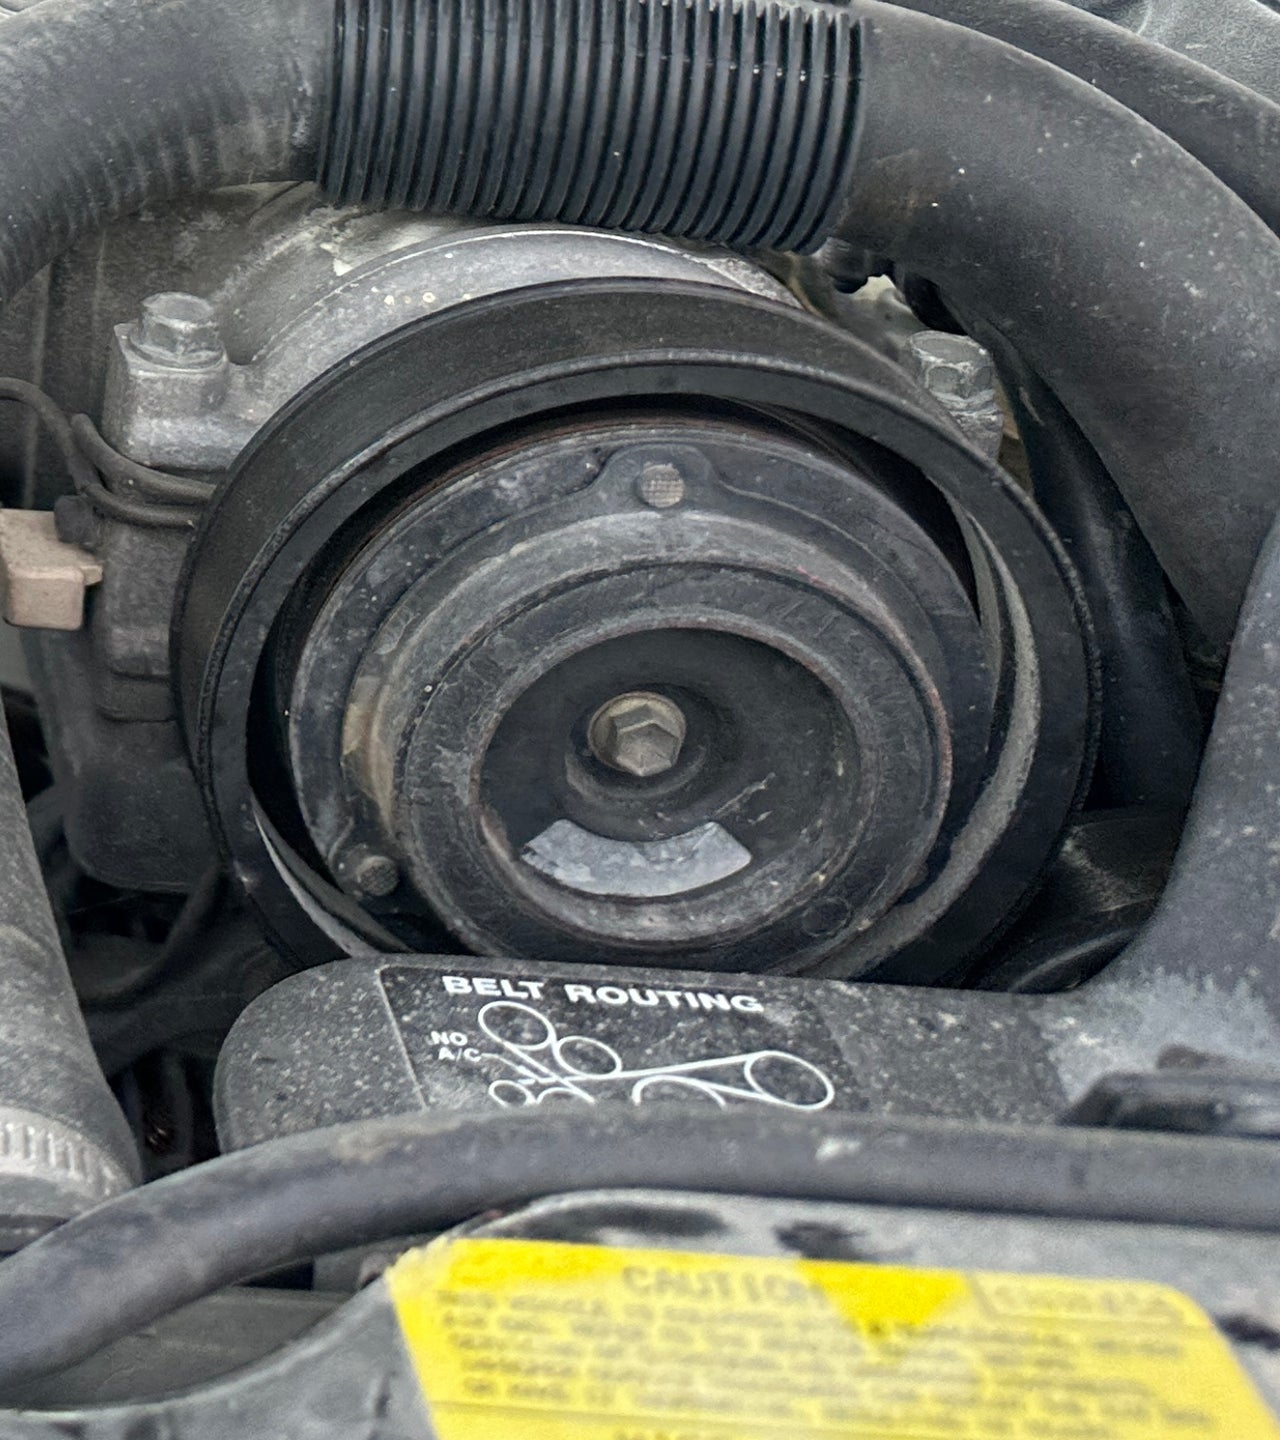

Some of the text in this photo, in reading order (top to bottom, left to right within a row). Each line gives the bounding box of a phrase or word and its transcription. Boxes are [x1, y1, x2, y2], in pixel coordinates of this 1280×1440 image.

[442, 976, 764, 1013] BELT ROUTING
[430, 1030, 468, 1046] NO
[438, 1047, 481, 1063] A/C
